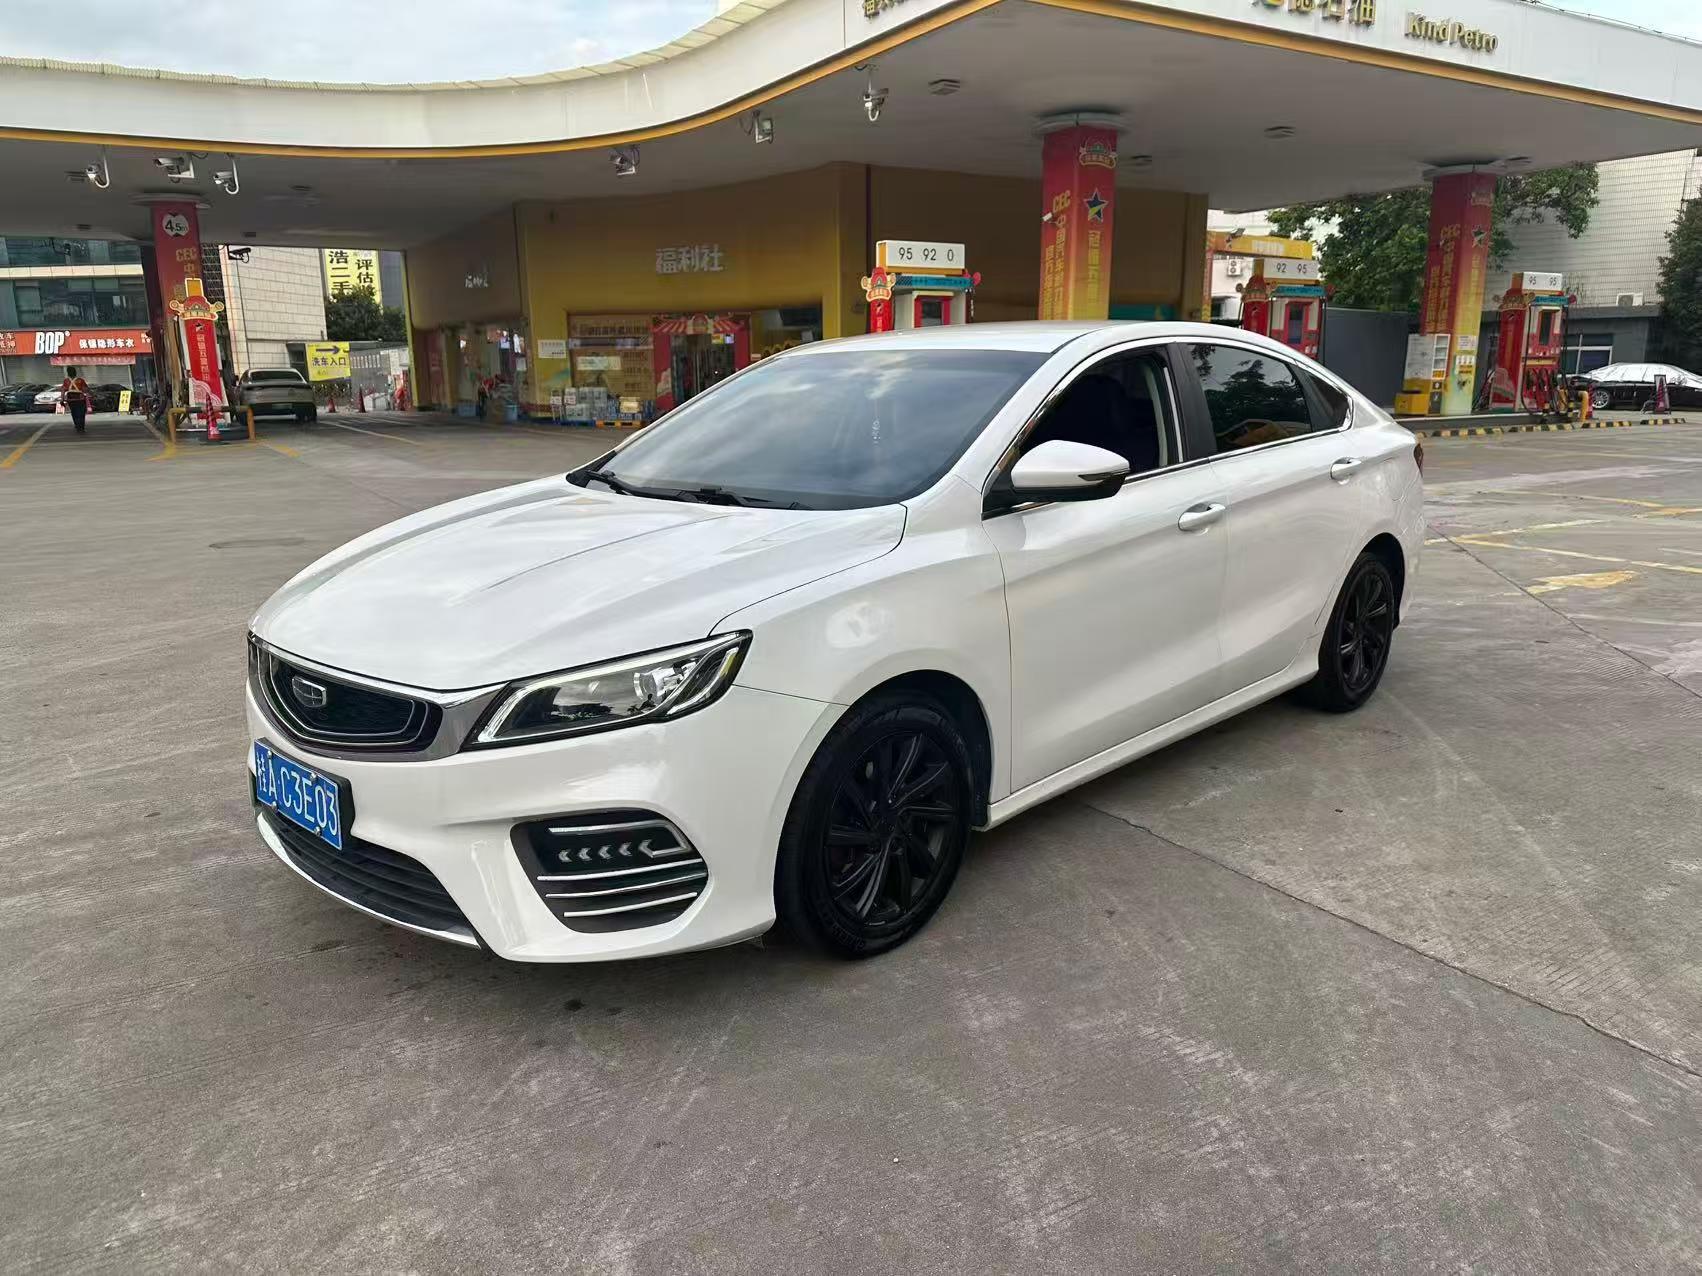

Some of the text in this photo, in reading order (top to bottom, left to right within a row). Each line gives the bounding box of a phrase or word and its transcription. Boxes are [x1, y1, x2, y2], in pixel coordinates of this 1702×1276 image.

[1405, 12, 1498, 52] Kind Petro
[656, 244, 724, 275] 福利社
[898, 247, 954, 261] 95 92 0
[1276, 263, 1307, 274] 92 95
[1528, 276, 1557, 286] 95 95
[35, 331, 64, 354] BOP
[312, 356, 346, 367] 洗车入口
